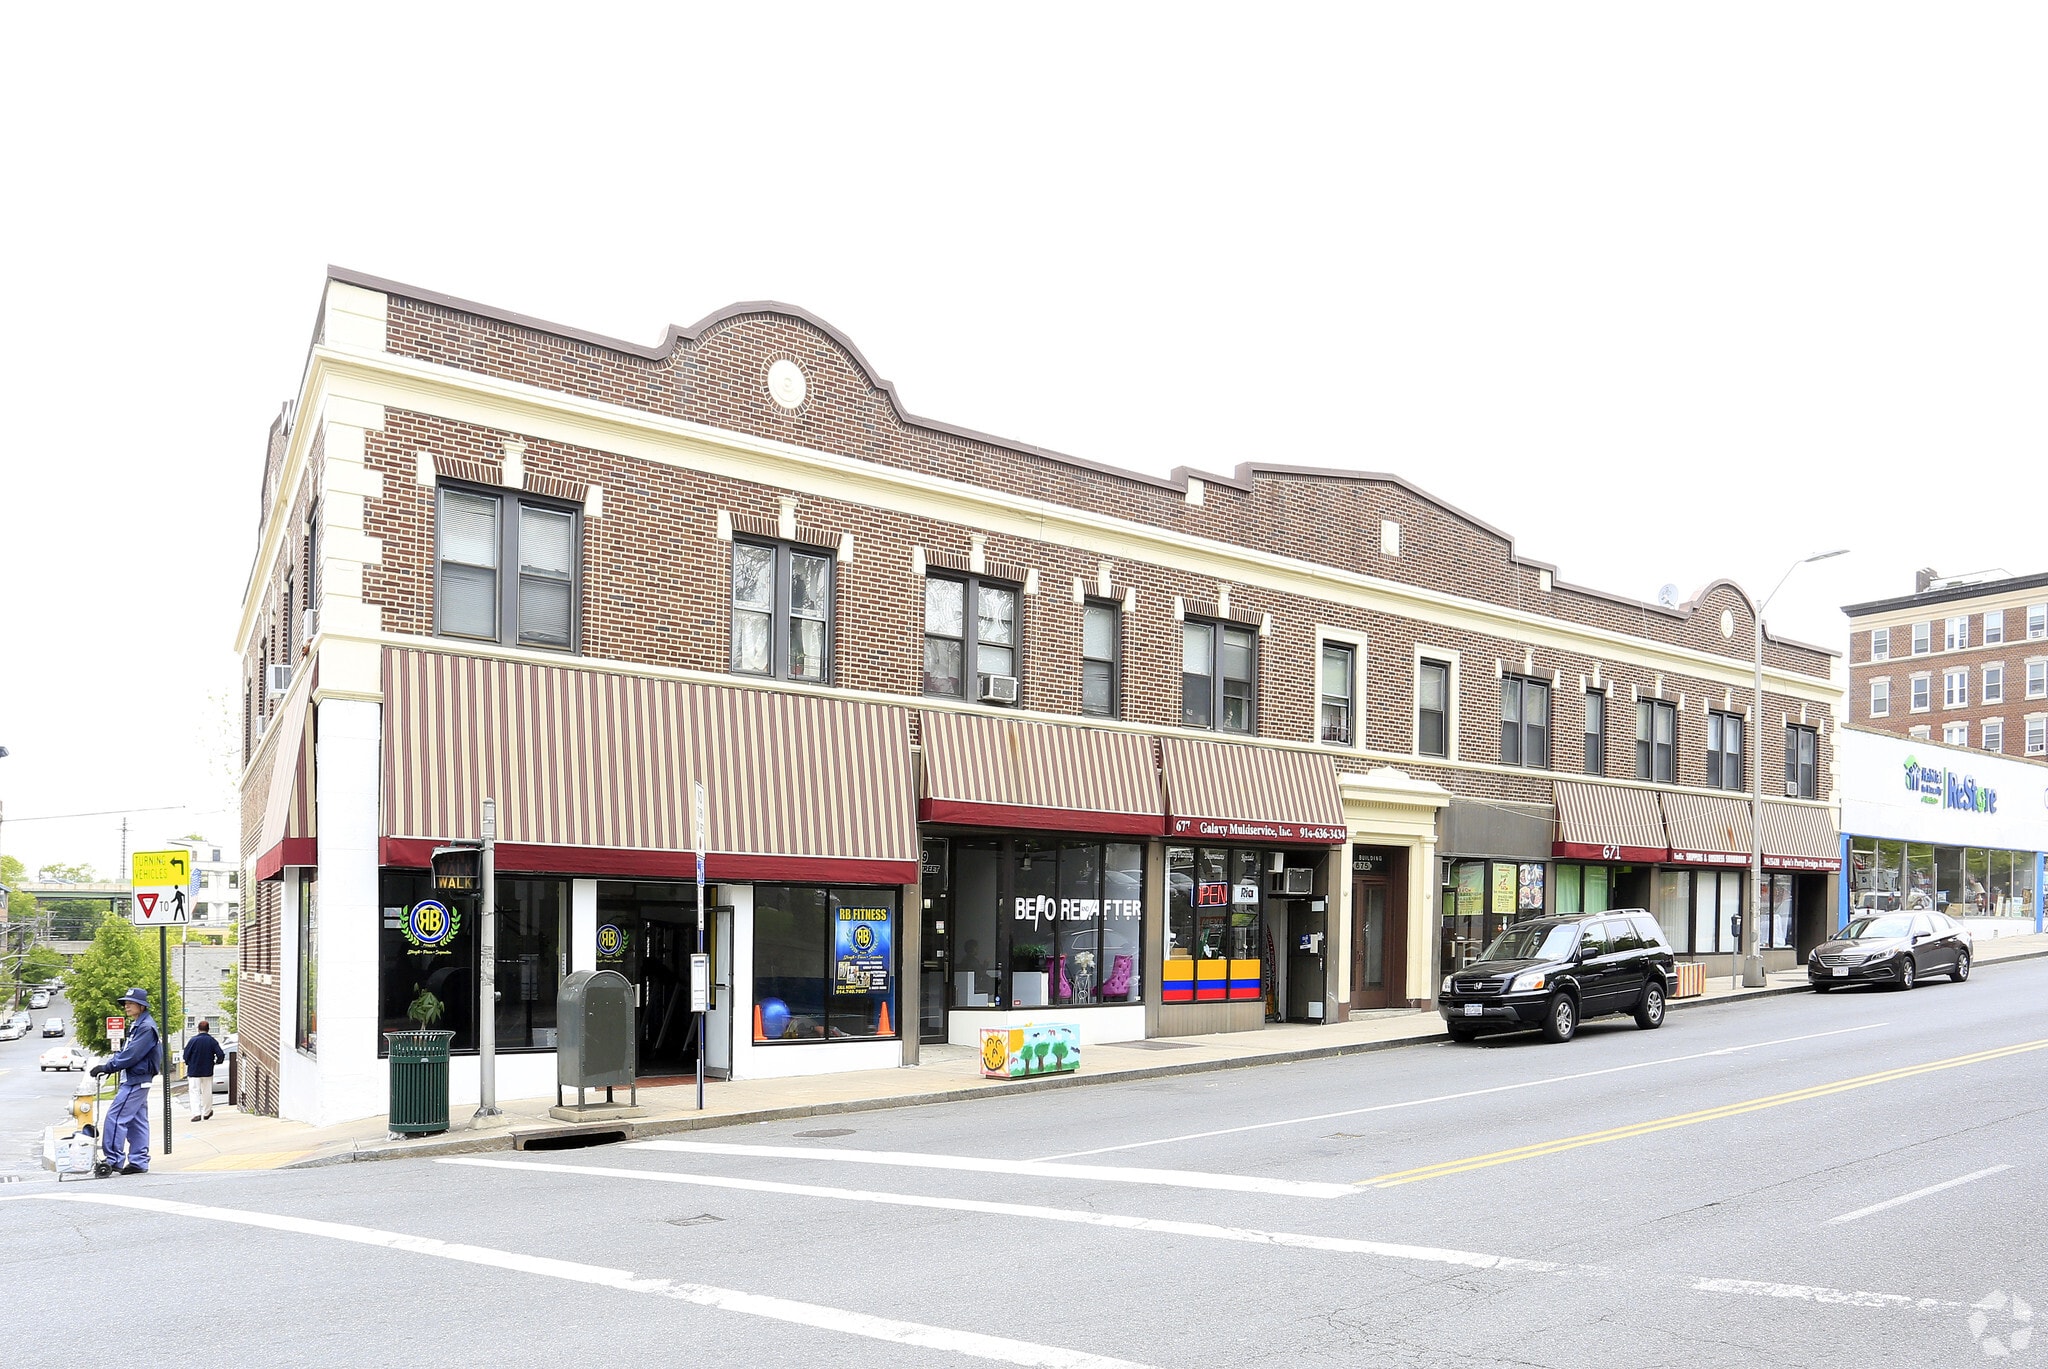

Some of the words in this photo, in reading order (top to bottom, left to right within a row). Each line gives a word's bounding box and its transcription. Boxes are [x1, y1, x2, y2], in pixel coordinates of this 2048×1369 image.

[1947, 772, 1998, 814] ReStore
[1602, 845, 1621, 860] 671
[135, 855, 166, 866] TURNING
[1355, 862, 1370, 870] 675
[135, 868, 168, 880] VEHICLES
[439, 876, 473, 889] WALK
[1240, 887, 1254, 898] Ria
[160, 900, 170, 912] TO
[839, 908, 851, 920] RB
[853, 908, 887, 921] FITNESS
